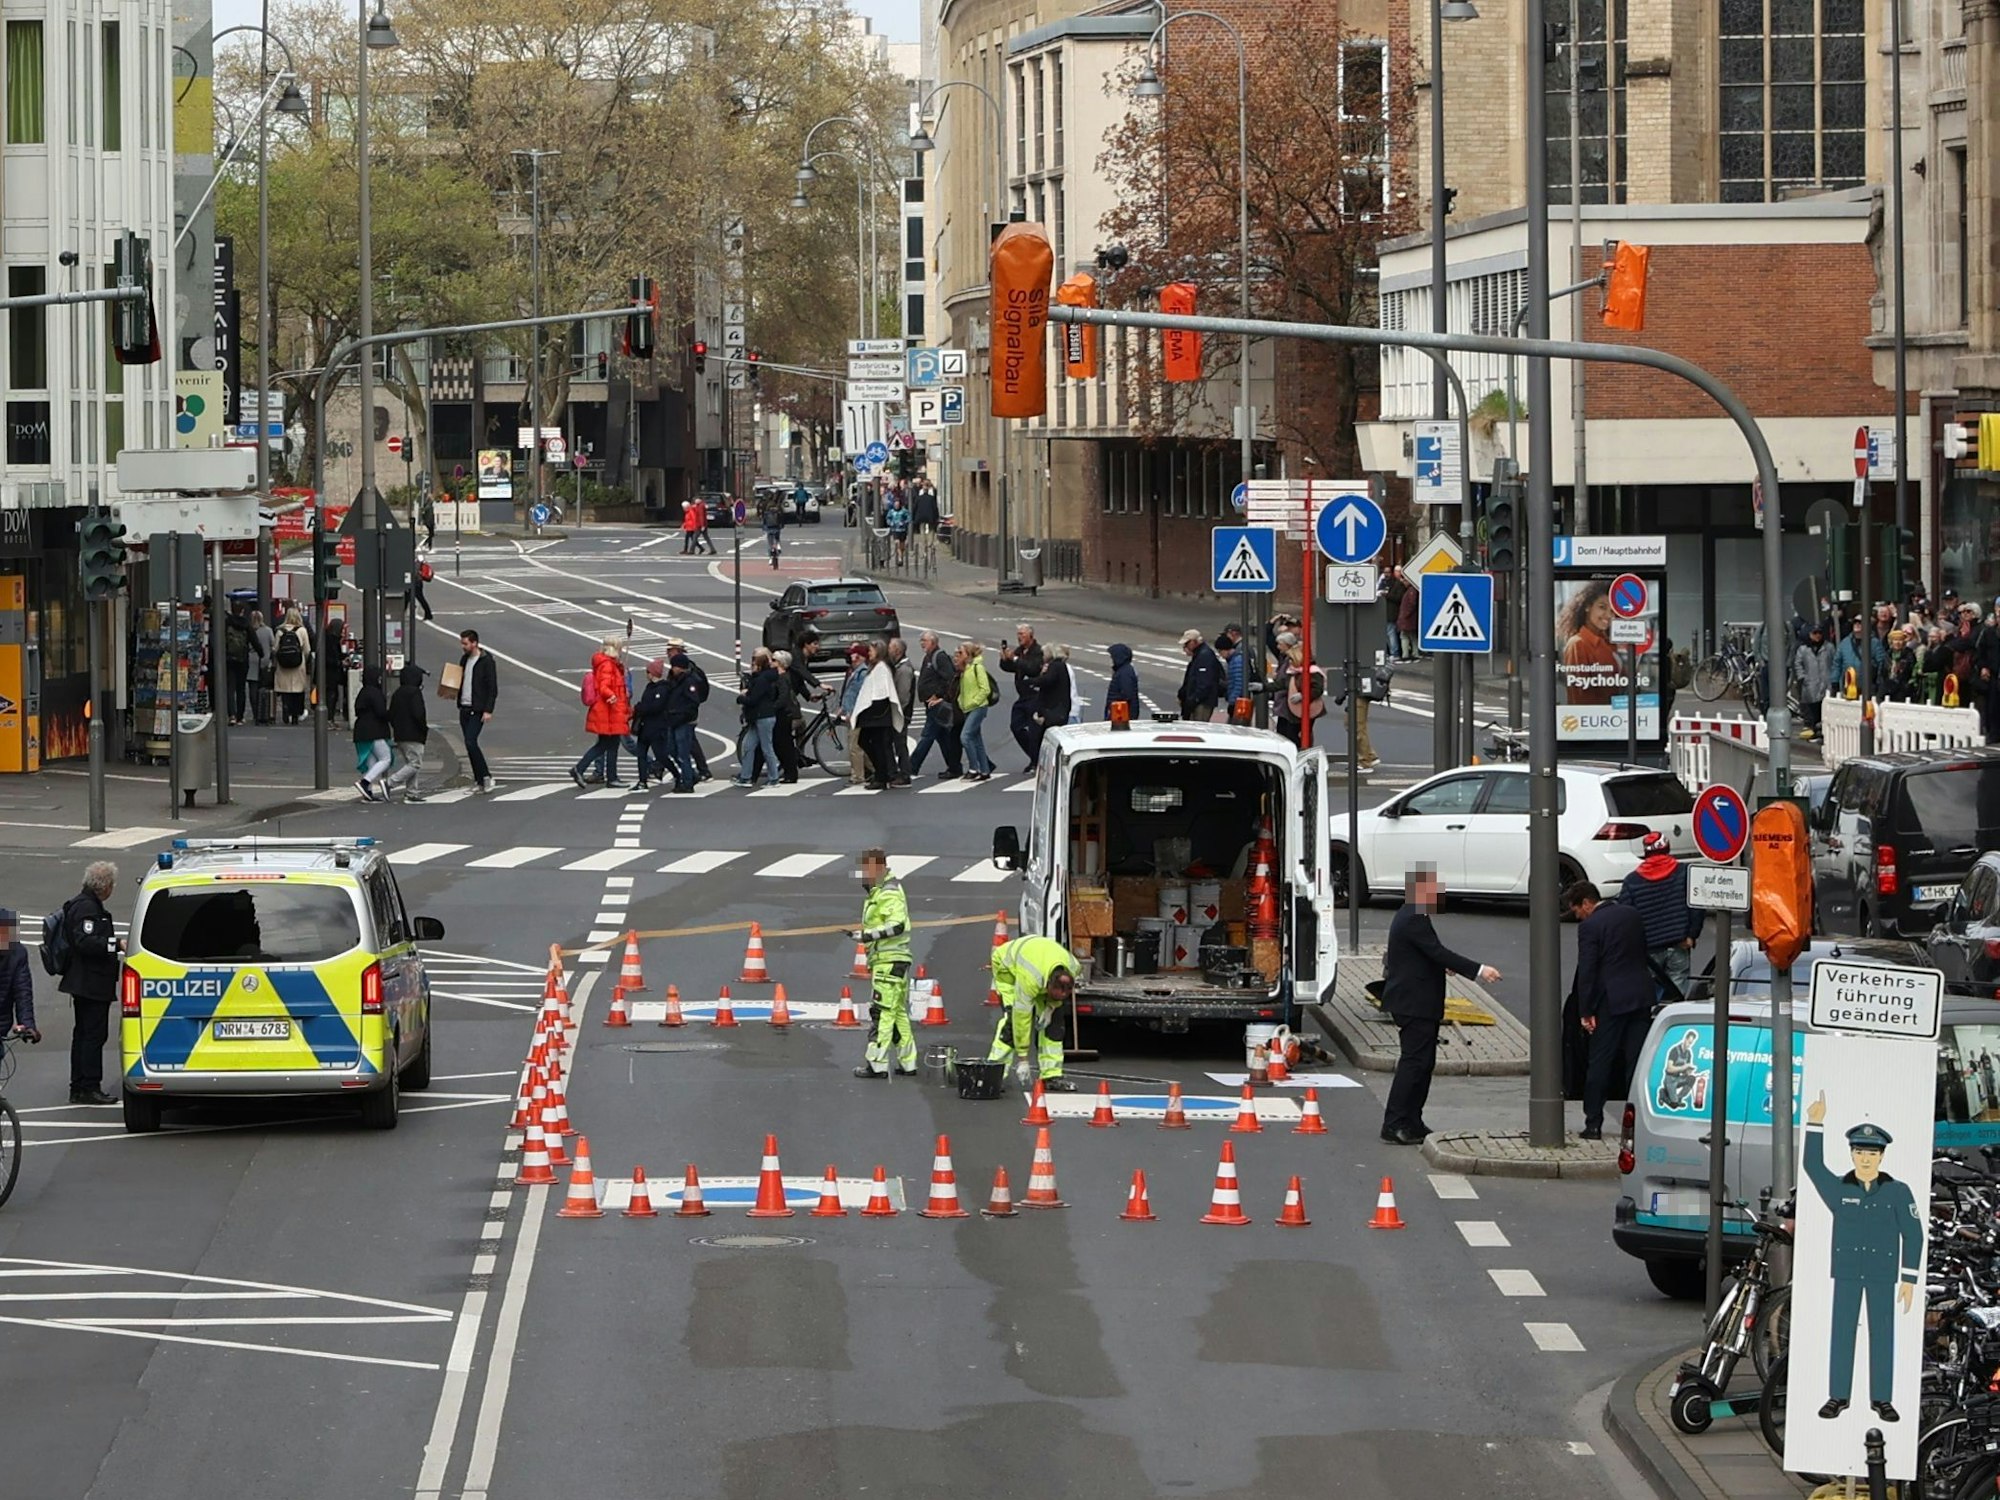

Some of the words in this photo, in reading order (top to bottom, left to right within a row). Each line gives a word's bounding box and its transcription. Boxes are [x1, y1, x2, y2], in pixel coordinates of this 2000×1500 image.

[1029, 288, 1044, 328] Sila
[1003, 289, 1027, 394] Signalbau
[917, 359, 934, 378] P
[946, 393, 958, 407] P
[921, 401, 935, 417] P
[15, 420, 49, 441] DOM
[4, 508, 32, 547] DOM
[1577, 546, 1598, 555] Dom
[1603, 546, 1662, 556] Hauptbahnhof
[1344, 589, 1360, 597] frei
[1555, 662, 1614, 673] Fernstudium
[1567, 673, 1651, 689] Psycholoie
[1580, 715, 1648, 727] EURO-H
[1753, 833, 1793, 842] SIEMENS
[1704, 875, 1716, 885] auf
[1717, 876, 1734, 886] dem
[1693, 886, 1744, 901] Snstreifen
[1826, 969, 1926, 989] Verkehrs-
[142, 980, 222, 997] POLIZEI
[1836, 988, 1914, 1010] führung
[1829, 1008, 1918, 1026] geändert
[221, 1023, 242, 1036] NRW
